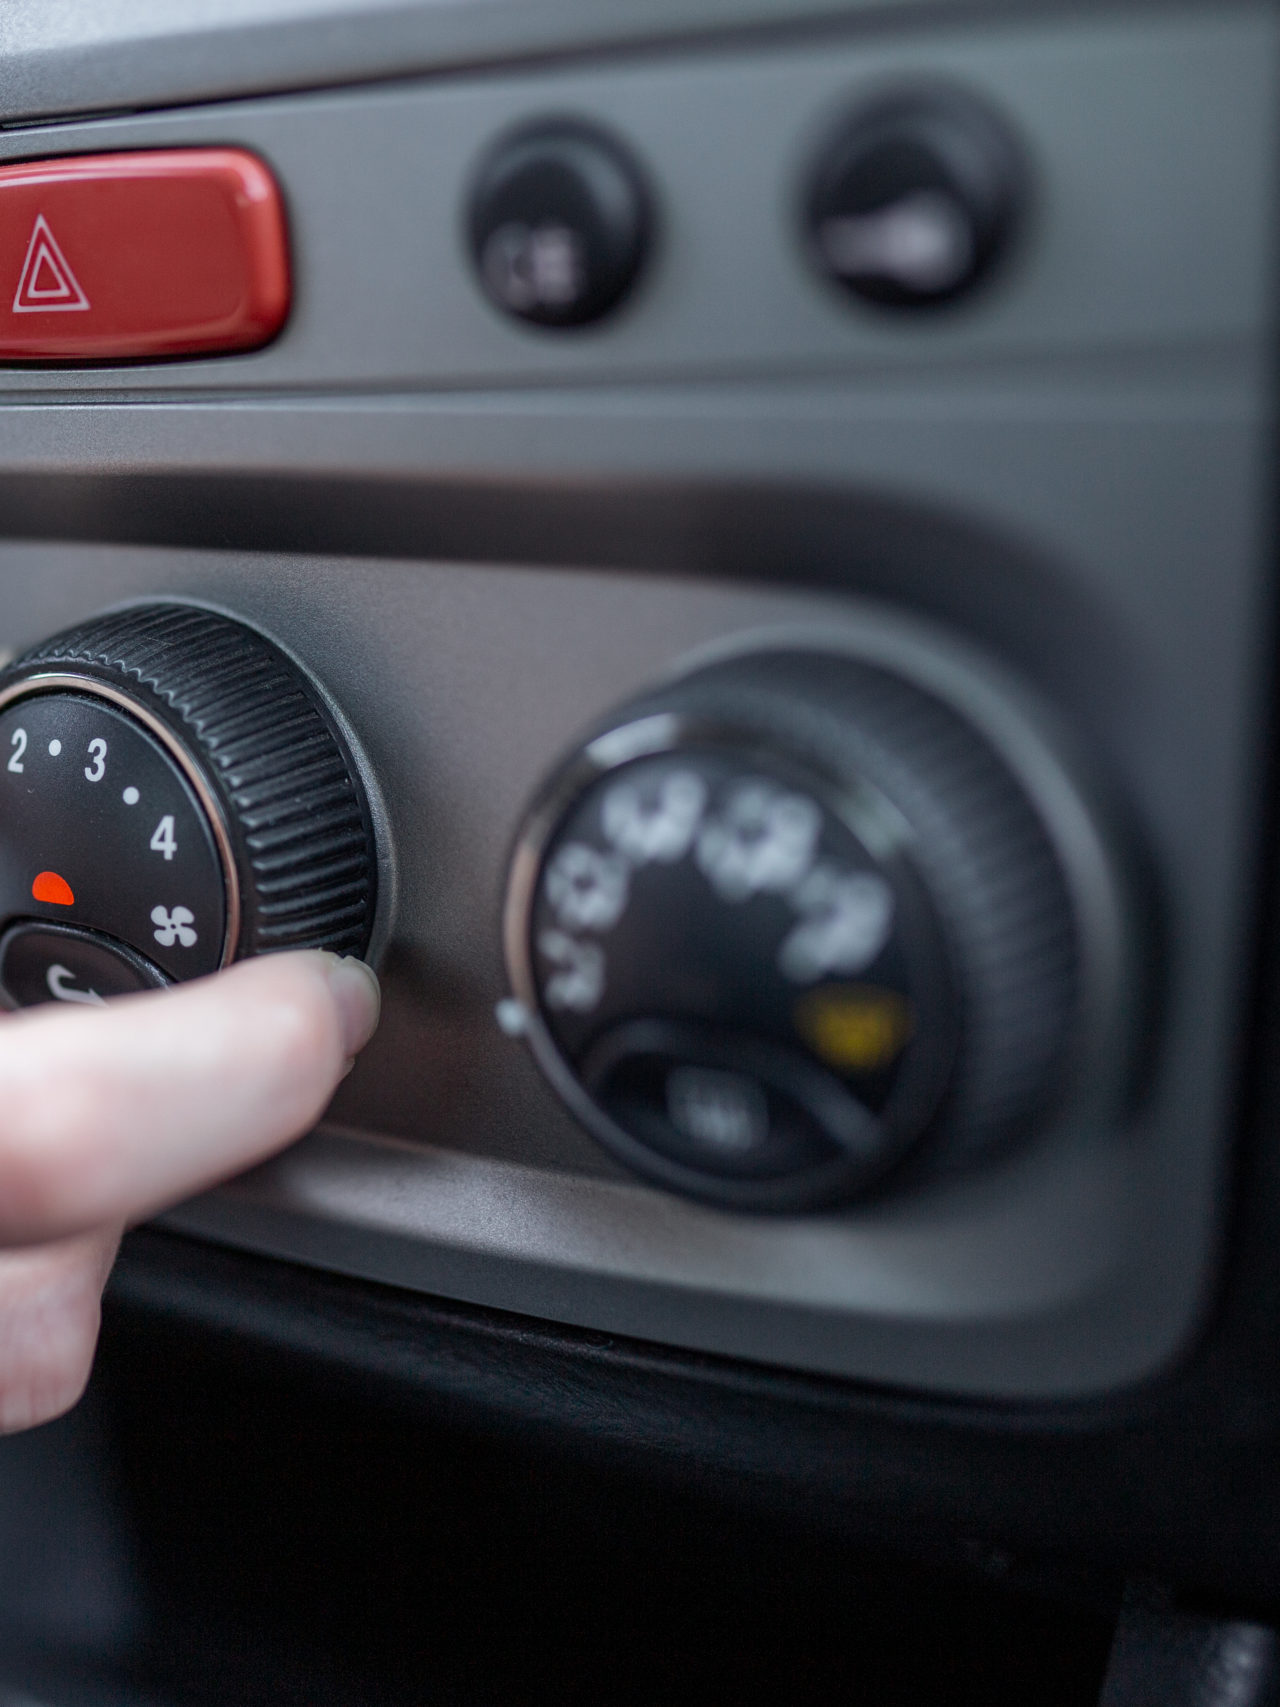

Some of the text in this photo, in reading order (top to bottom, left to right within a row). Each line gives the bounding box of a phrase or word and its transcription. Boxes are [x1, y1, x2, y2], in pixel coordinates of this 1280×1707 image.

[7, 728, 28, 773] 2
[83, 737, 109, 783] 3
[149, 815, 178, 861] 4
